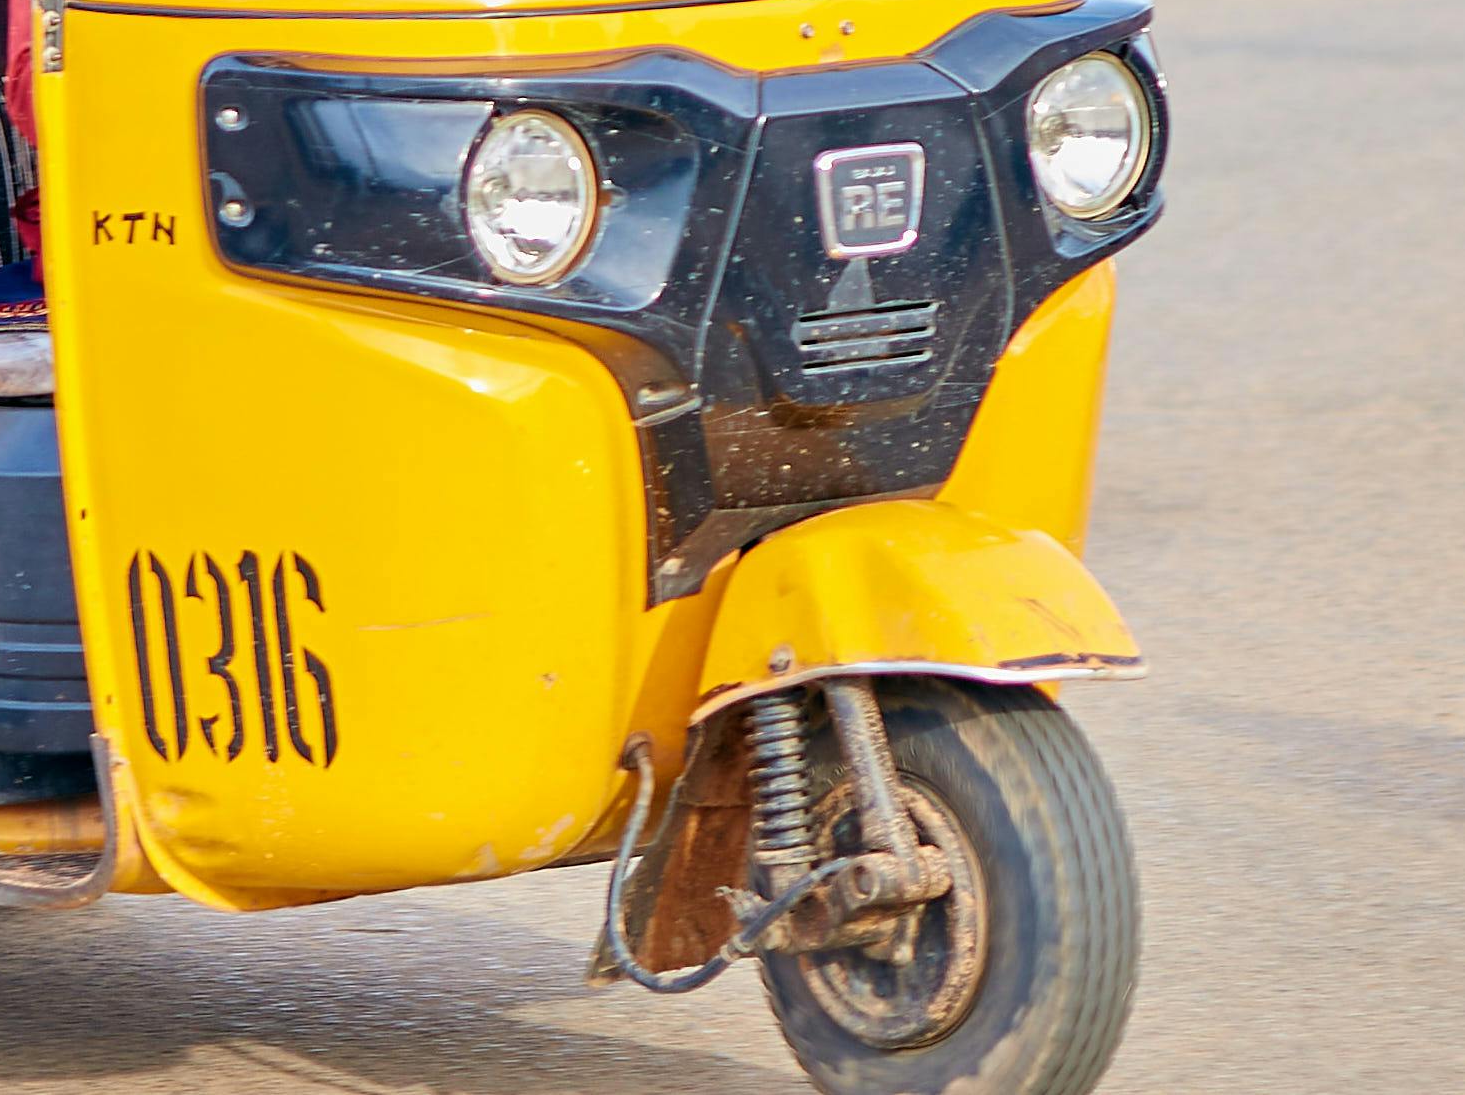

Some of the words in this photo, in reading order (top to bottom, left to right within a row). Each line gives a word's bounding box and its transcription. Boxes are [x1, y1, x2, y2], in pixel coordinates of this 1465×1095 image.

[92, 210, 175, 246] KTN
[840, 180, 906, 231] RE
[128, 550, 338, 769] 0316
